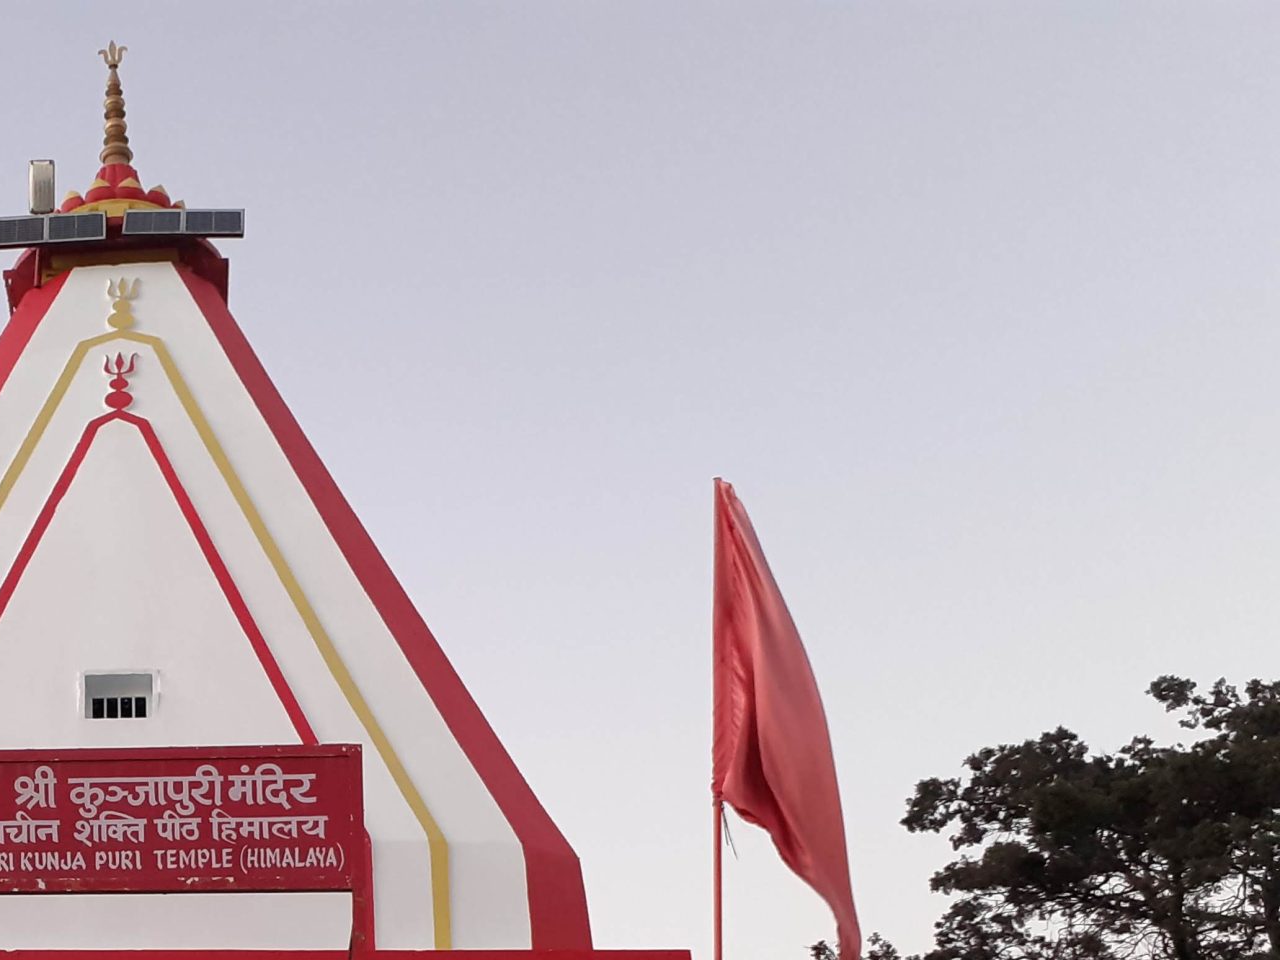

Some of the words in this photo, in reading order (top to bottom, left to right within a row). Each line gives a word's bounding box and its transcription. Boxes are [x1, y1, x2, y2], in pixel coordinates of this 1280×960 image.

[14, 765, 58, 810] श्री
[67, 764, 224, 818] कुञ्जापुरी
[228, 763, 317, 810] मंदिर
[73, 810, 147, 848] शक्ति
[153, 809, 202, 842] पीठ
[209, 808, 329, 845] हिमालय
[20, 849, 86, 872] KUNJA
[95, 848, 142, 871] PURI
[153, 848, 233, 870] TEMPLE
[239, 842, 345, 874] (HIMALAYA)
